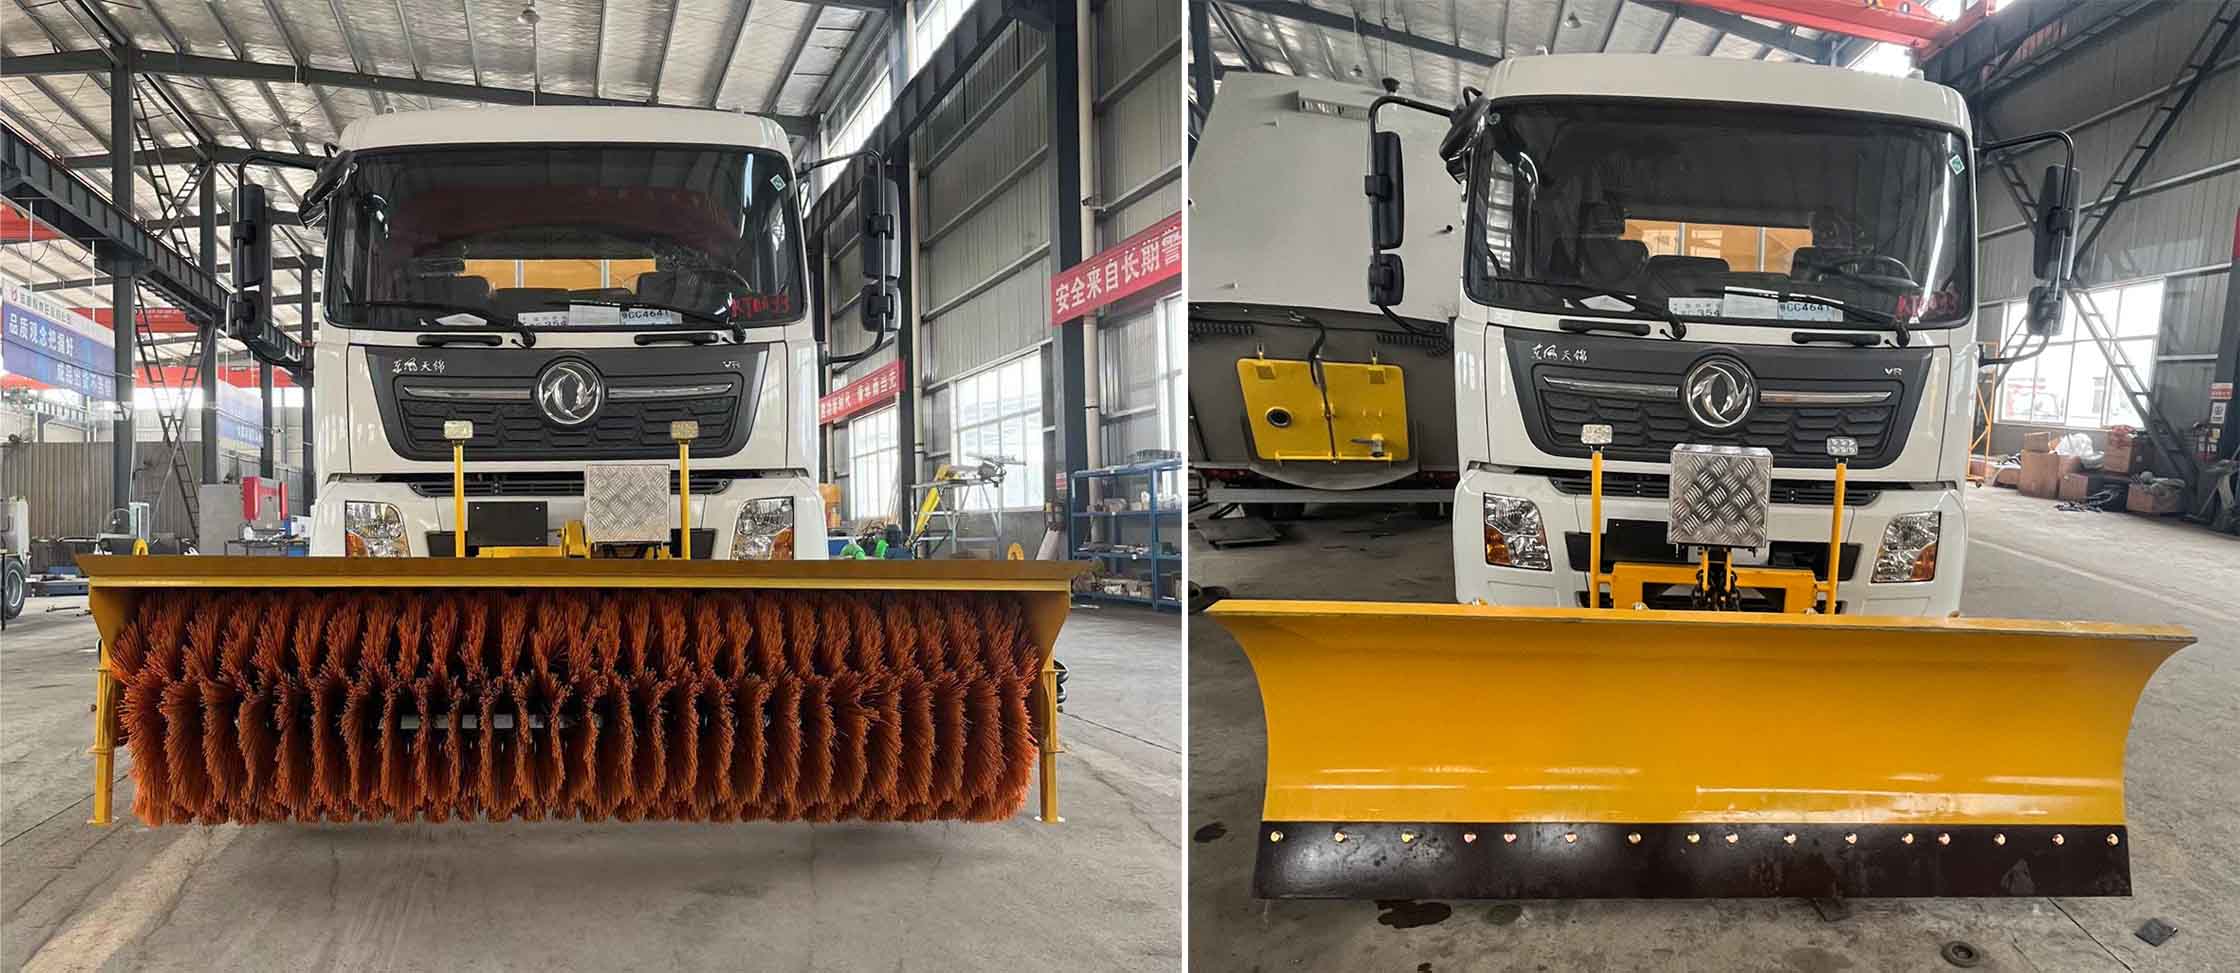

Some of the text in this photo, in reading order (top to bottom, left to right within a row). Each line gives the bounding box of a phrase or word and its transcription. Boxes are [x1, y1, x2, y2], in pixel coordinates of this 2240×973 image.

[1056, 225, 1182, 315] 安全来自长期警
